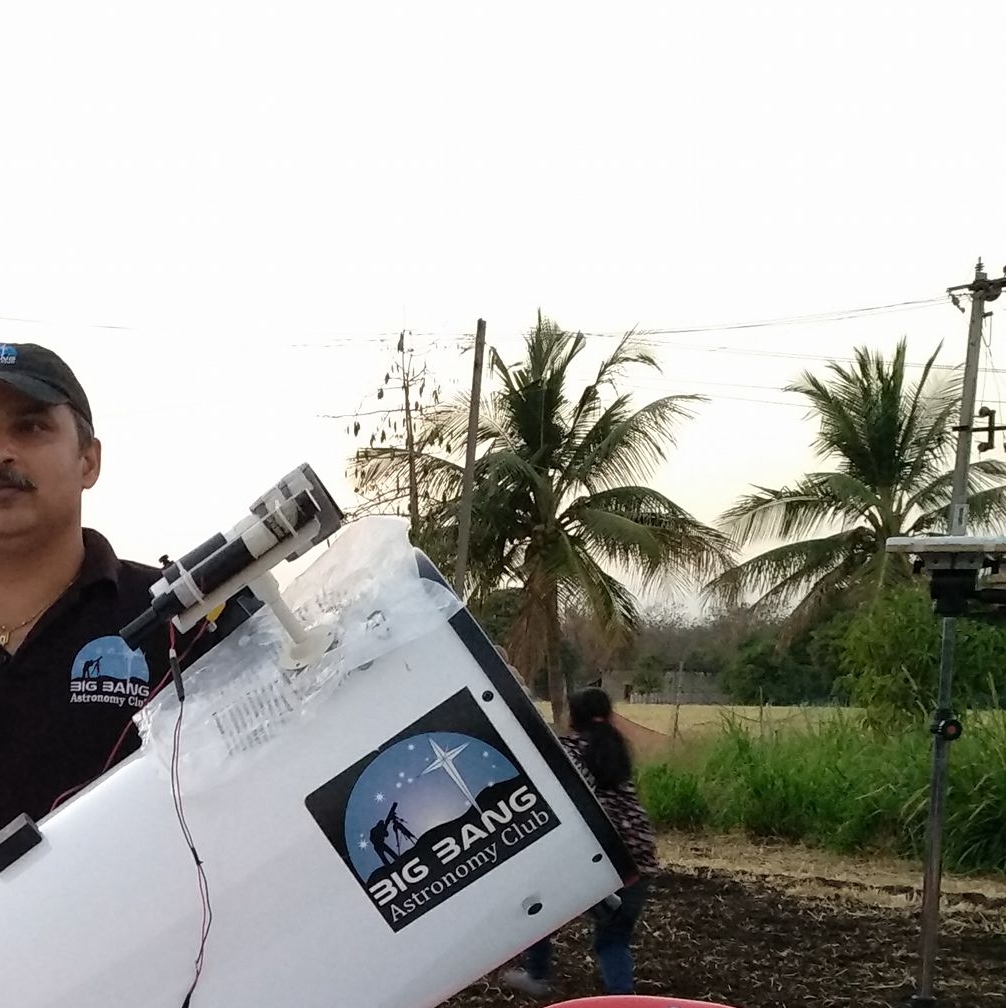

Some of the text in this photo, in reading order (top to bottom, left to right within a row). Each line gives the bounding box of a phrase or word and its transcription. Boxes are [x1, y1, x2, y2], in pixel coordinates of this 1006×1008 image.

[70, 680, 150, 697] BIG BANG
[70, 693, 147, 707] Astronomy Clu
[369, 785, 537, 907] BIG BANG
[390, 810, 550, 923] Astronomy Club
